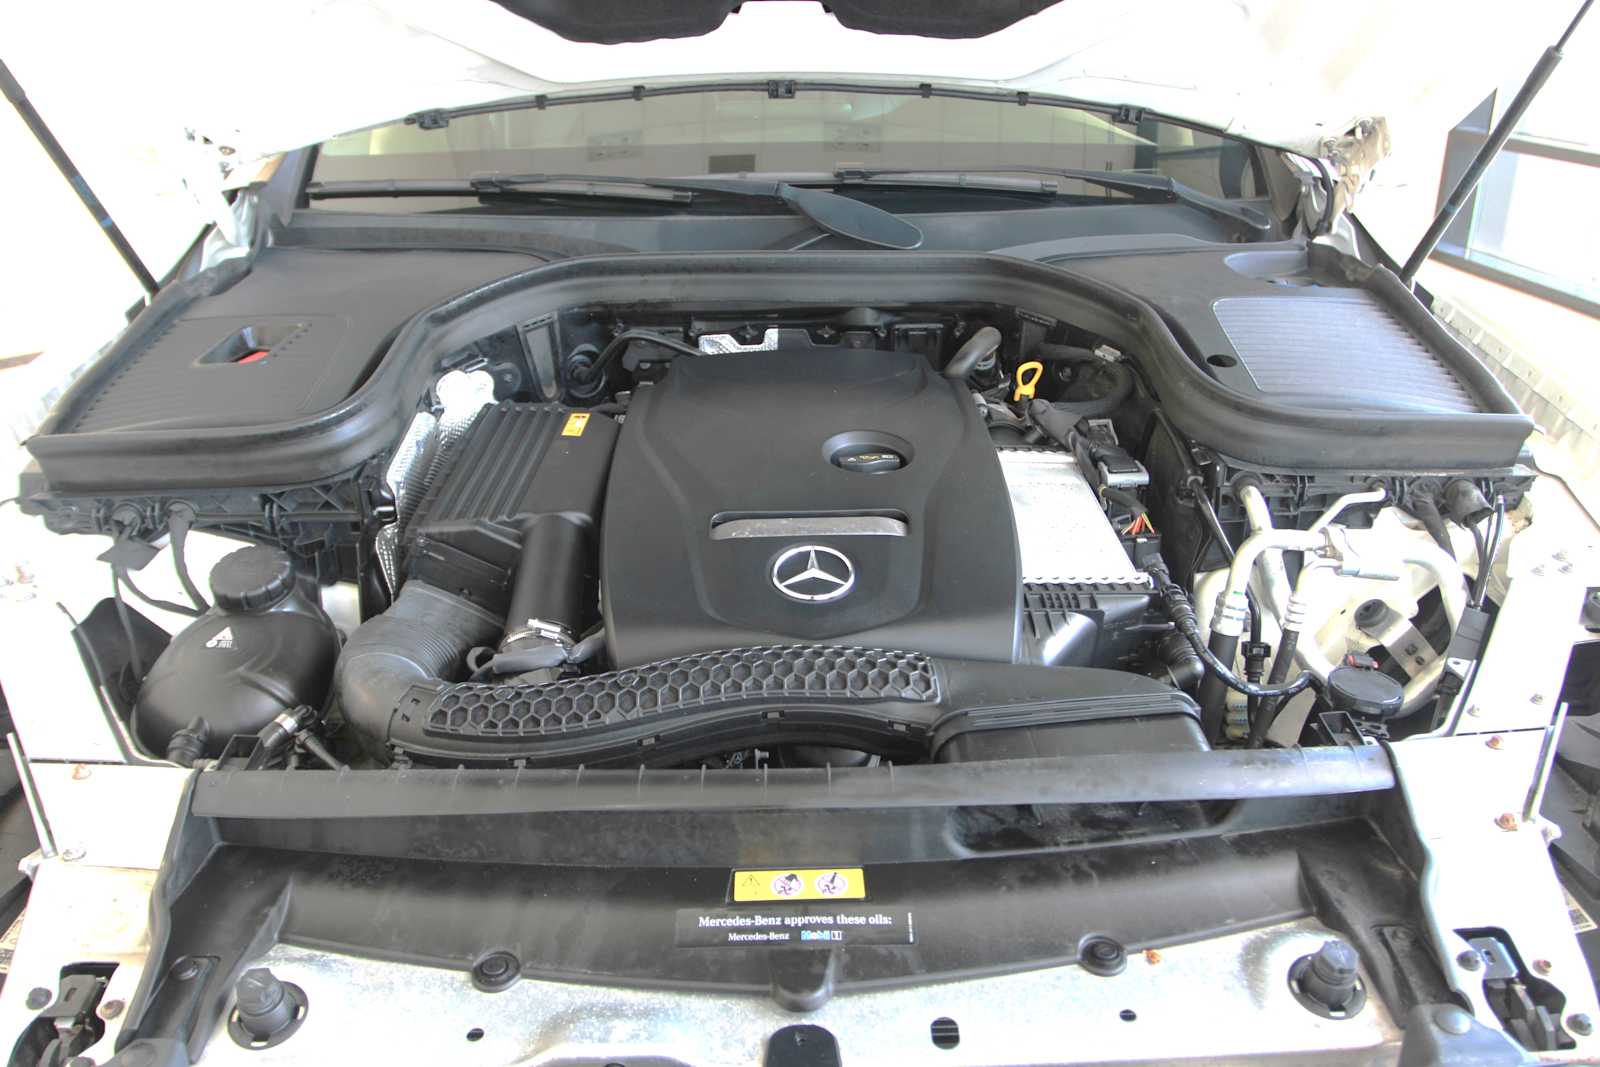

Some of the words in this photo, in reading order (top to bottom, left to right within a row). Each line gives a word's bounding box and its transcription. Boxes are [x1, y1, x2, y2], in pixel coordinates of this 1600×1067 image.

[698, 915, 782, 928] Mercedes-Benz
[784, 914, 834, 927] approves
[836, 913, 866, 925] these
[868, 913, 892, 925] oils:
[728, 932, 790, 941] Mercedes-Benz
